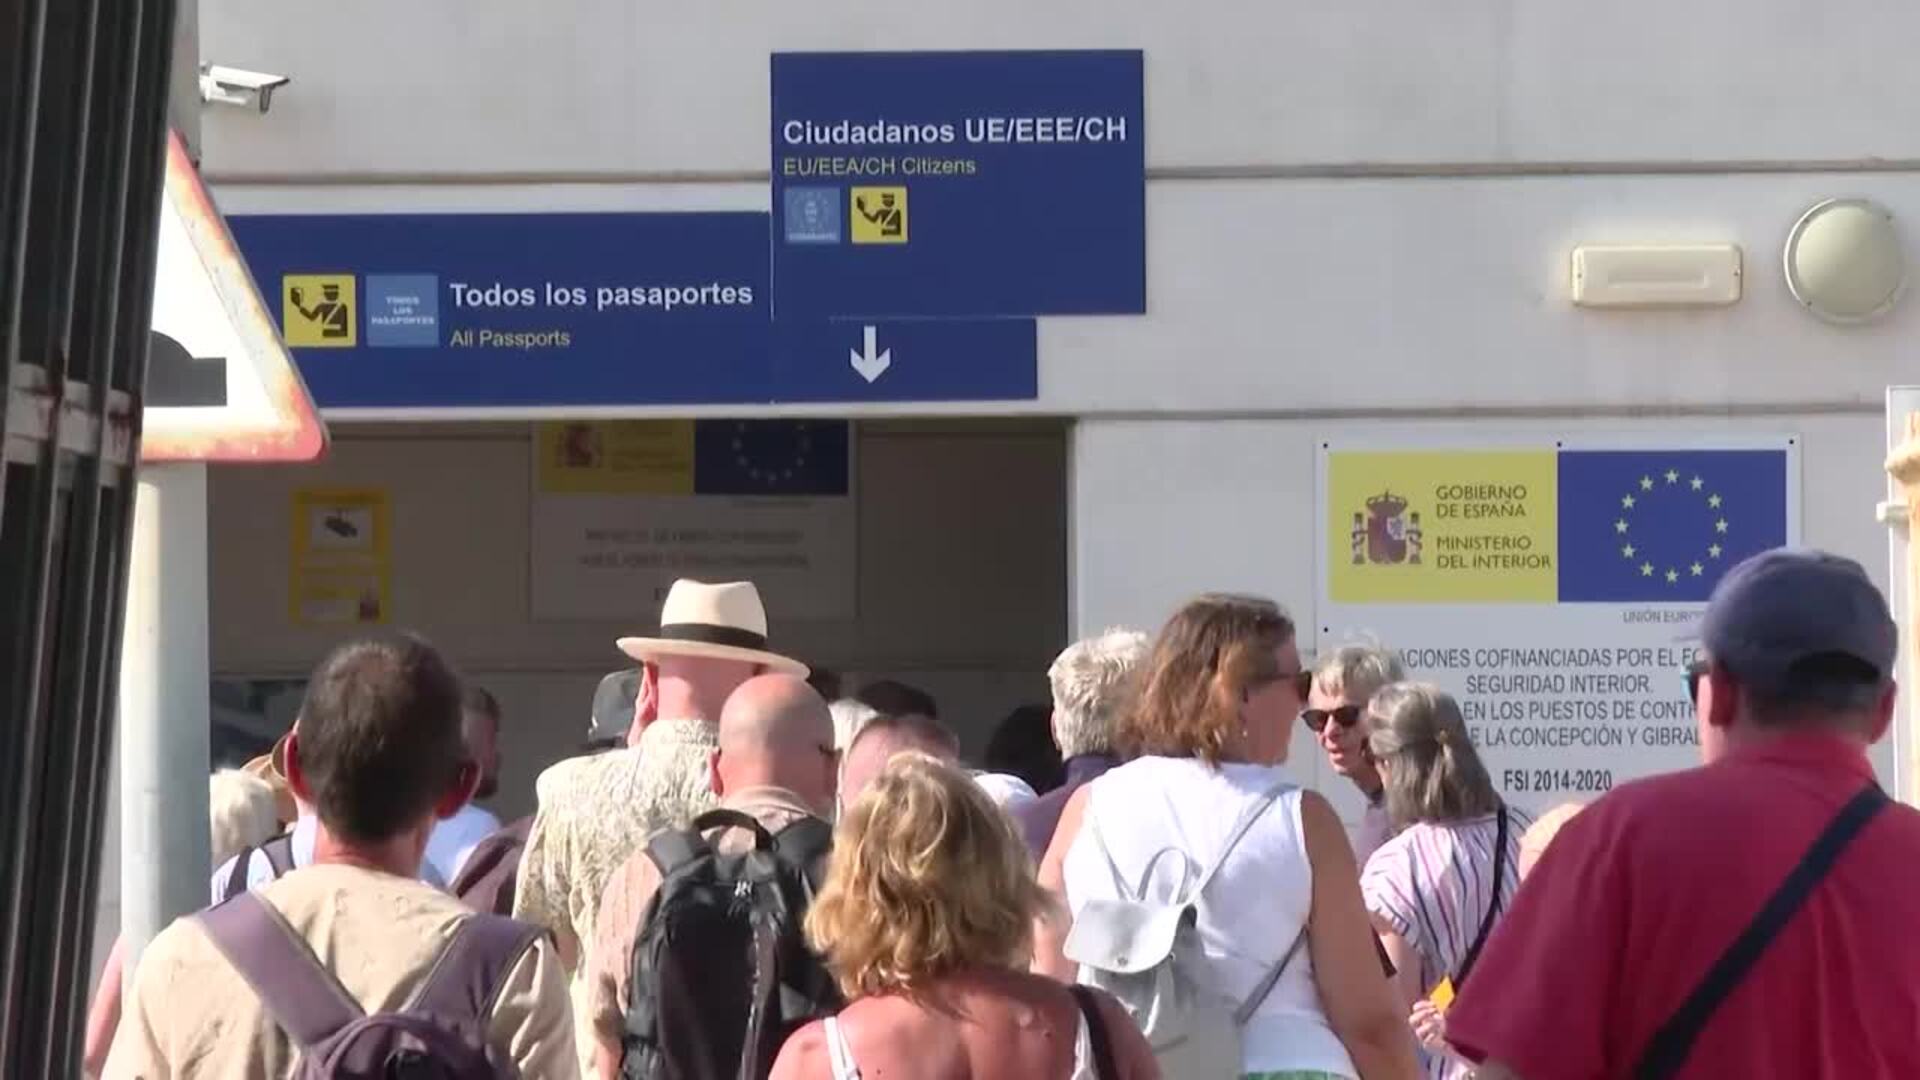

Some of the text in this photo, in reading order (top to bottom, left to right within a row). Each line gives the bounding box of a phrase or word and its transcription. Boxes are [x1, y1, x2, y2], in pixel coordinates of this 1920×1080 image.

[783, 117, 1126, 145] Ciudadanos UE/EEE/CH
[783, 157, 976, 176] EU/EEA/CH Citizens
[449, 282, 753, 311] Todos los pasaportes
[450, 329, 571, 351] All Passports
[1436, 484, 1527, 501] GOBIERNO
[1436, 500, 1526, 519] DE ESPAÑA
[1436, 535, 1532, 551] MINISTERIO
[1437, 553, 1551, 569] DEL INTERIOR
[1623, 608, 1661, 623] UNIÓN
[1475, 648, 1612, 668] COFINANCIADAS
[1616, 648, 1653, 667] POR
[1658, 647, 1678, 667] EL
[1466, 674, 1654, 694] SEGURIDAD INTERIOR.
[1463, 700, 1486, 720] EN
[1490, 700, 1524, 720] LOS
[1529, 700, 1608, 720] PUESTOS
[1613, 701, 1635, 720] DE
[1485, 727, 1507, 746] LA
[1510, 724, 1622, 747] CONCEPCIÓN
[1627, 727, 1639, 746] Y
[1503, 769, 1613, 792] FSI 2014-2020
